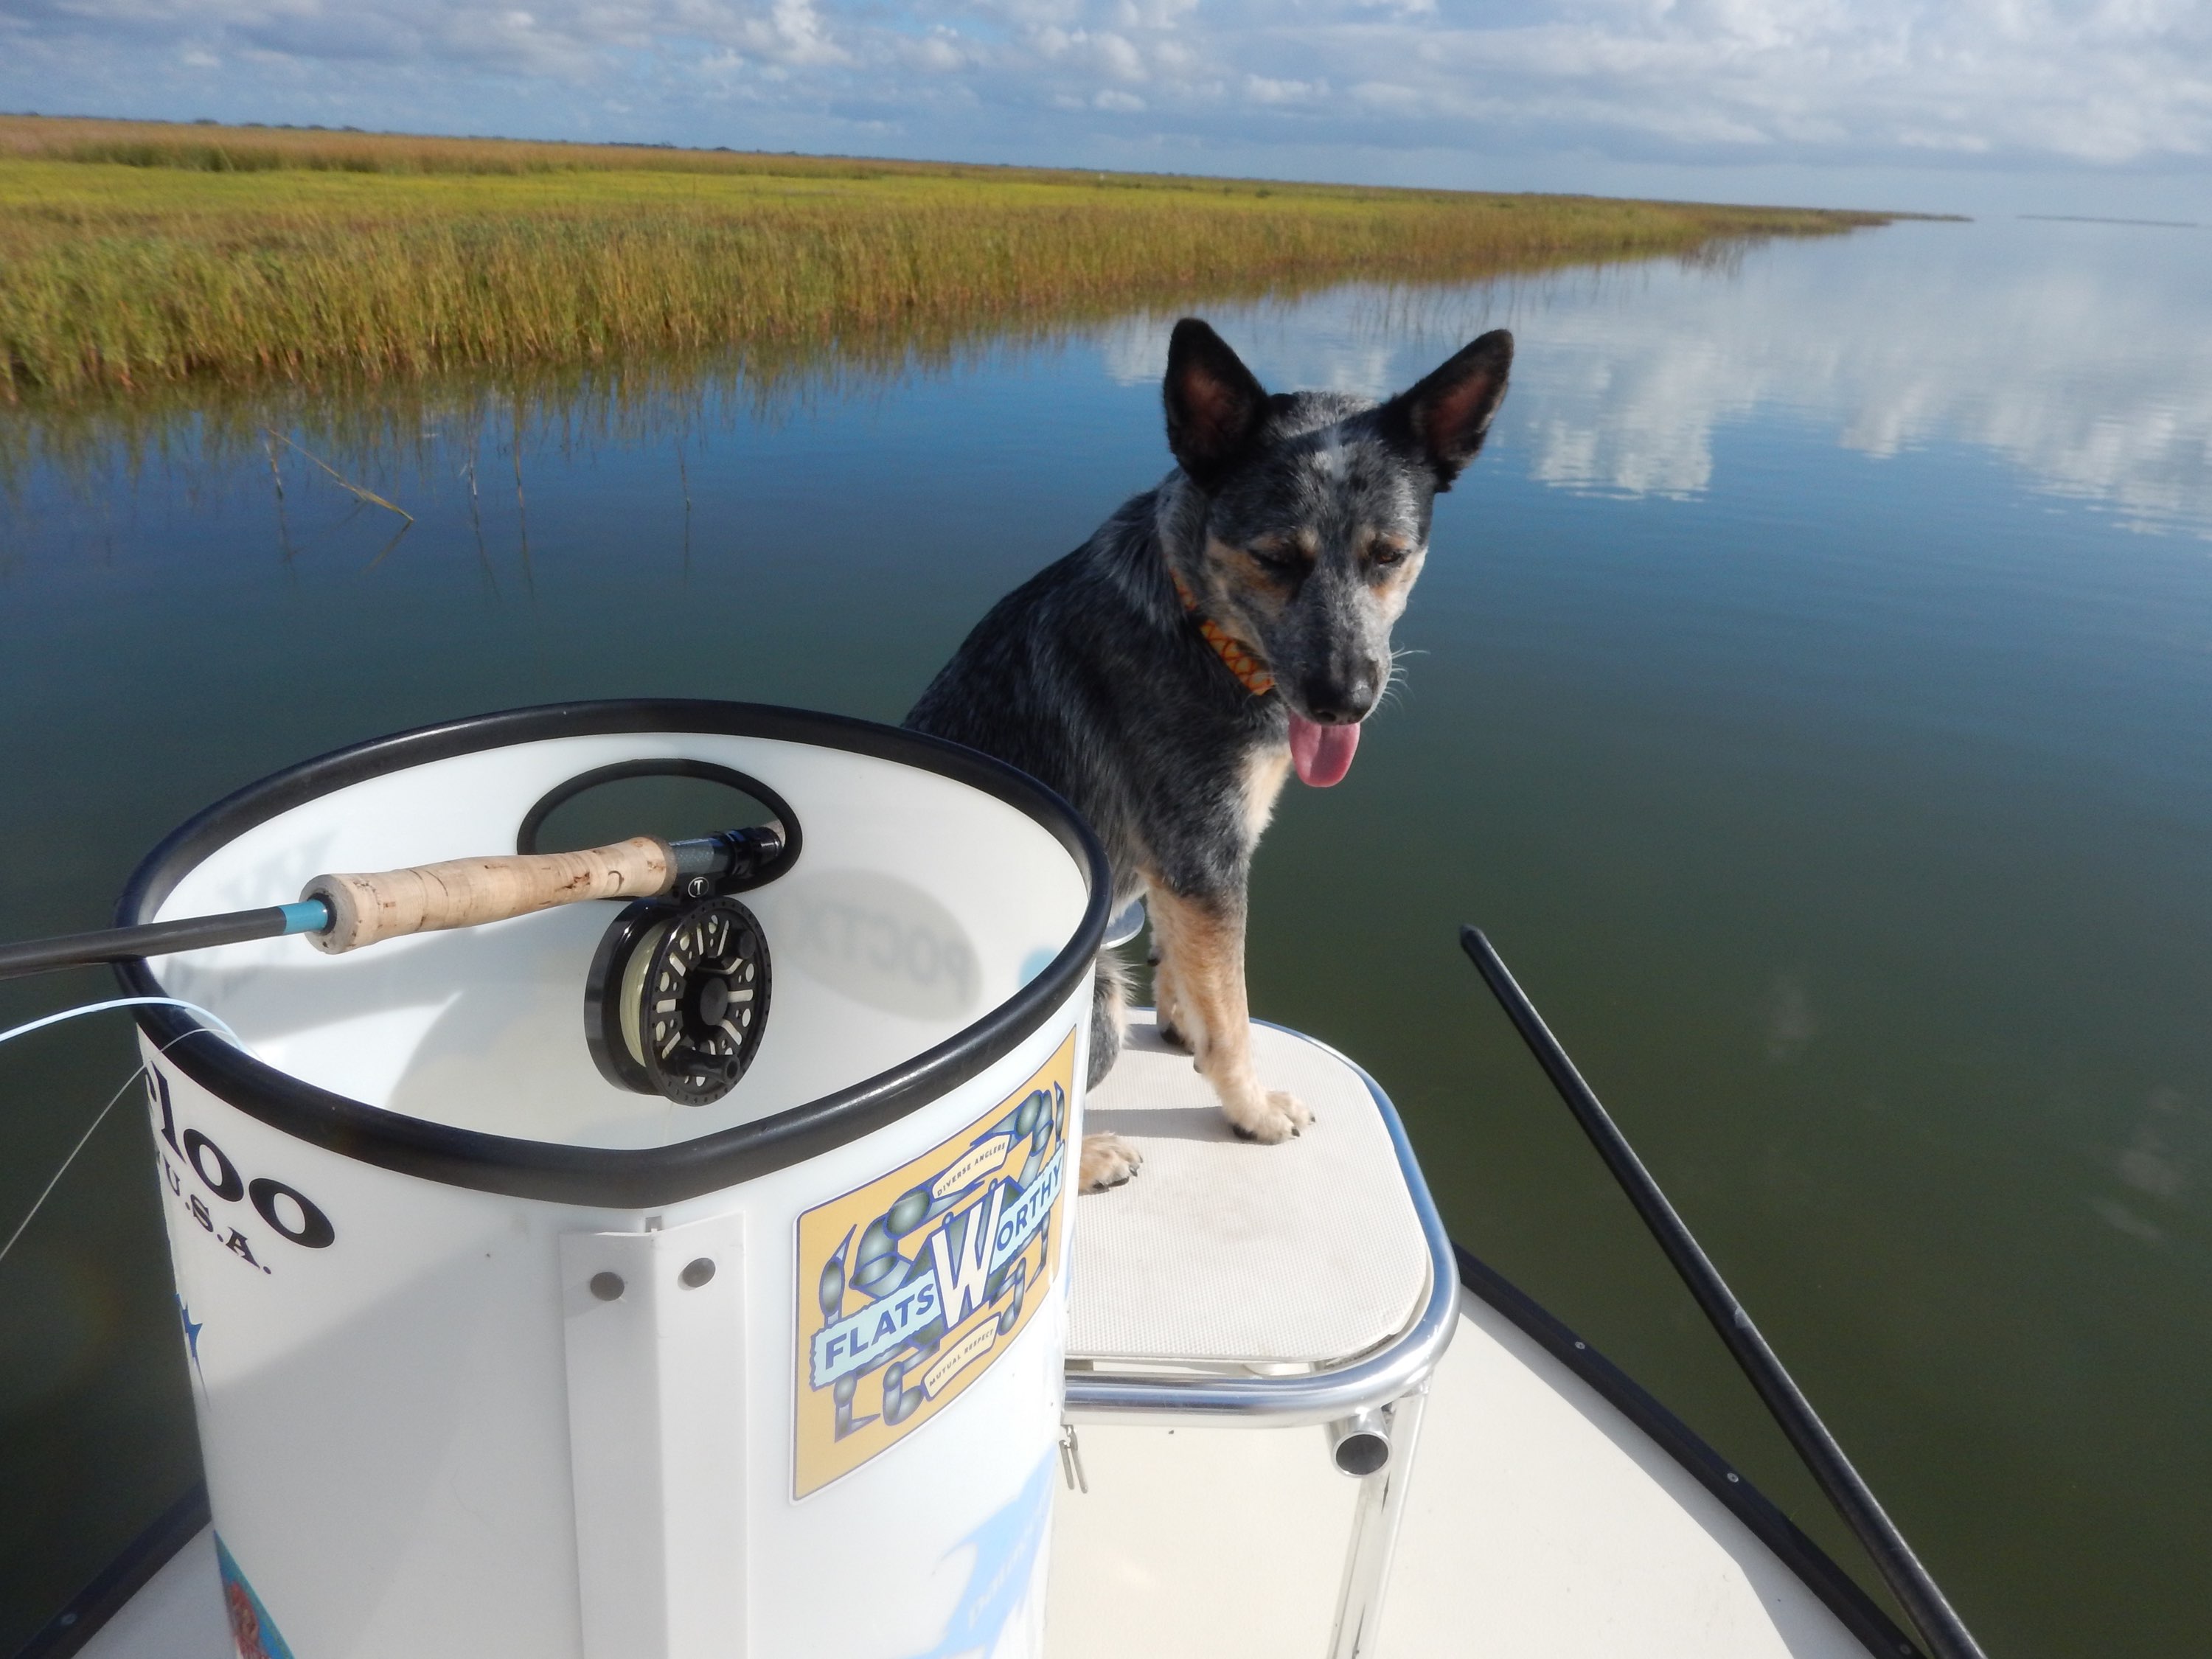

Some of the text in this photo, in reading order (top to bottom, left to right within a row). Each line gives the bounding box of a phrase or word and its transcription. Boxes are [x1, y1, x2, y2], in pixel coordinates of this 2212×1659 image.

[693, 880, 703, 895] T
[936, 1142, 1006, 1197] DIVERSE ANGLERS
[825, 1155, 1062, 1371] FLATS WORTHY
[929, 1328, 994, 1387] MUTUAL RESPECT
